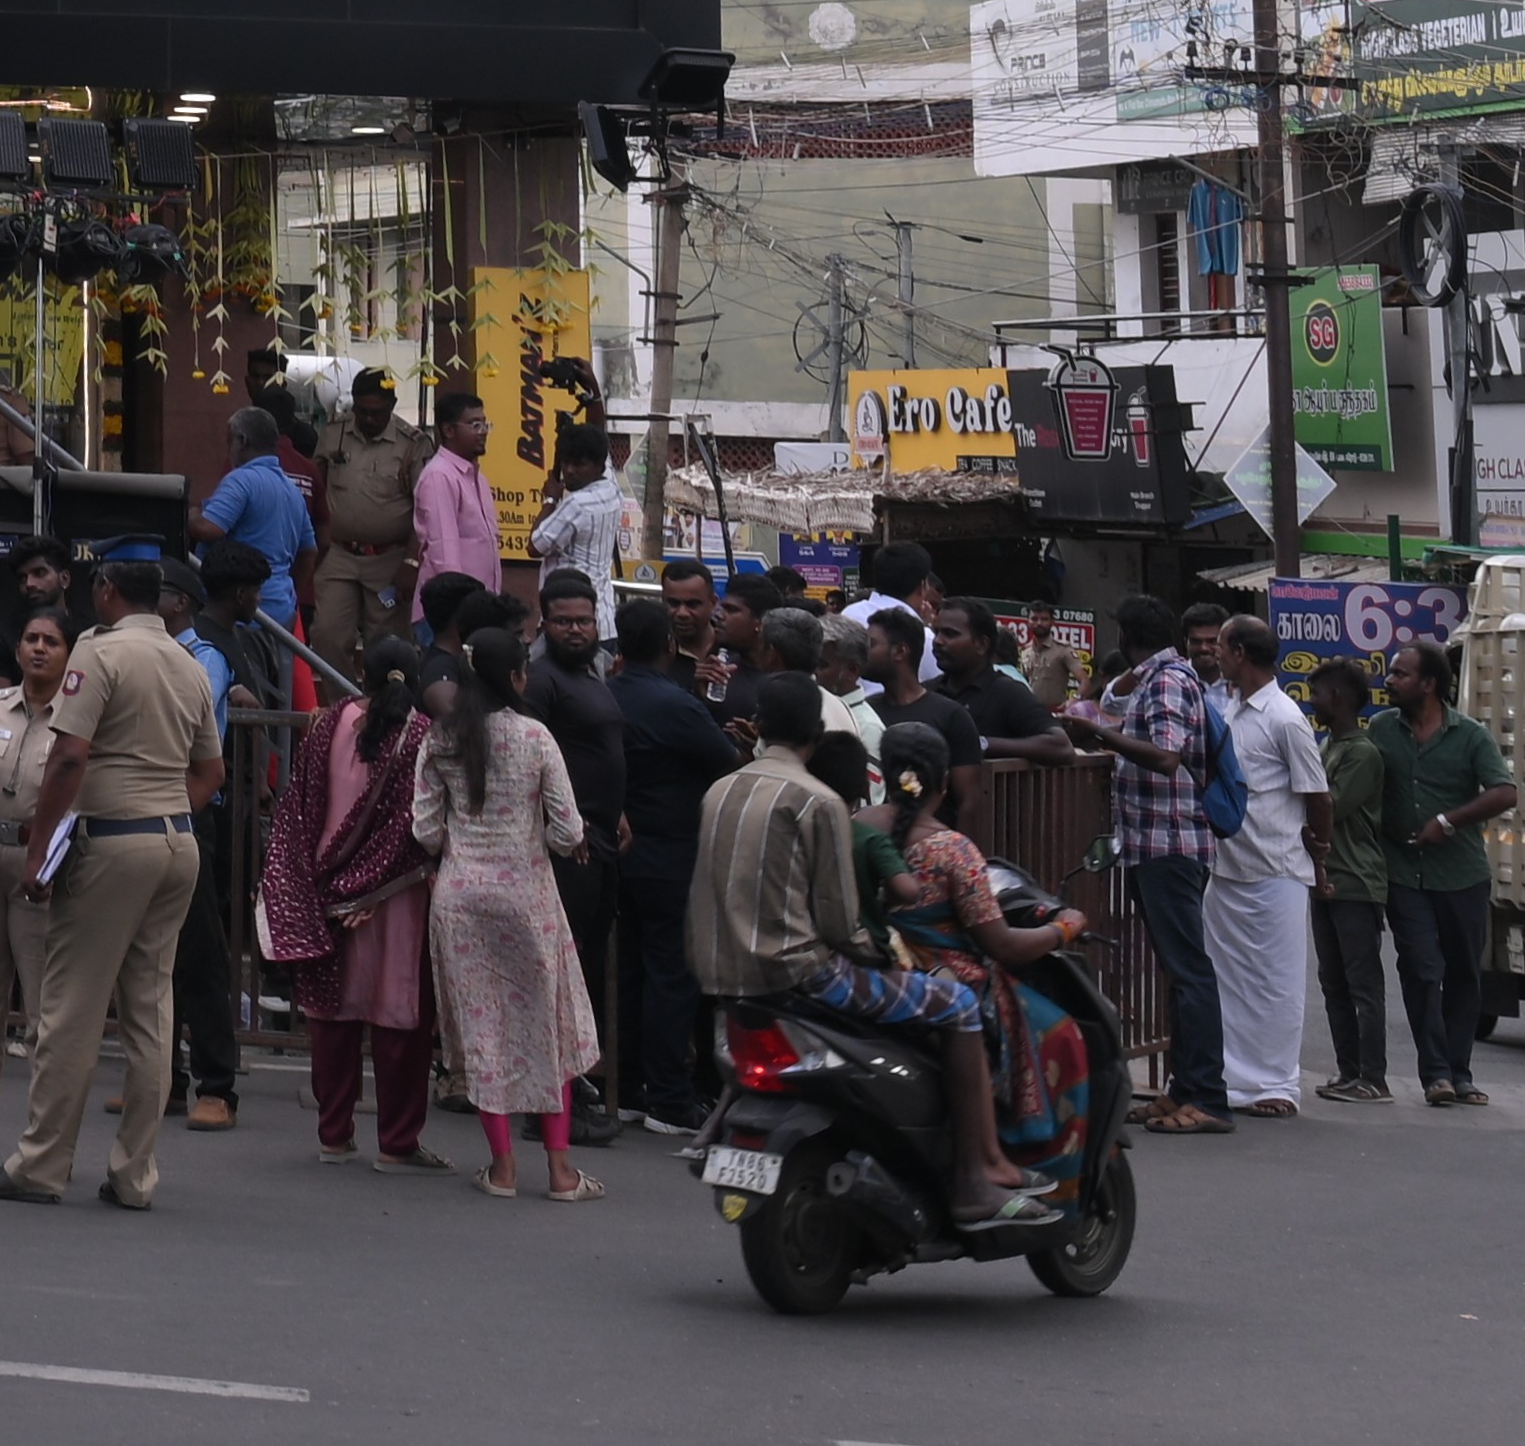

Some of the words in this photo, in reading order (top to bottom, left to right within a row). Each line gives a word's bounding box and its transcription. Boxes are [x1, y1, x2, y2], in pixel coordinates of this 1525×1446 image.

[1309, 316, 1336, 350] SG
[887, 385, 938, 433] Ero
[945, 383, 1013, 434] Cafe
[1014, 422, 1036, 448] The
[1277, 611, 1342, 643] காலை
